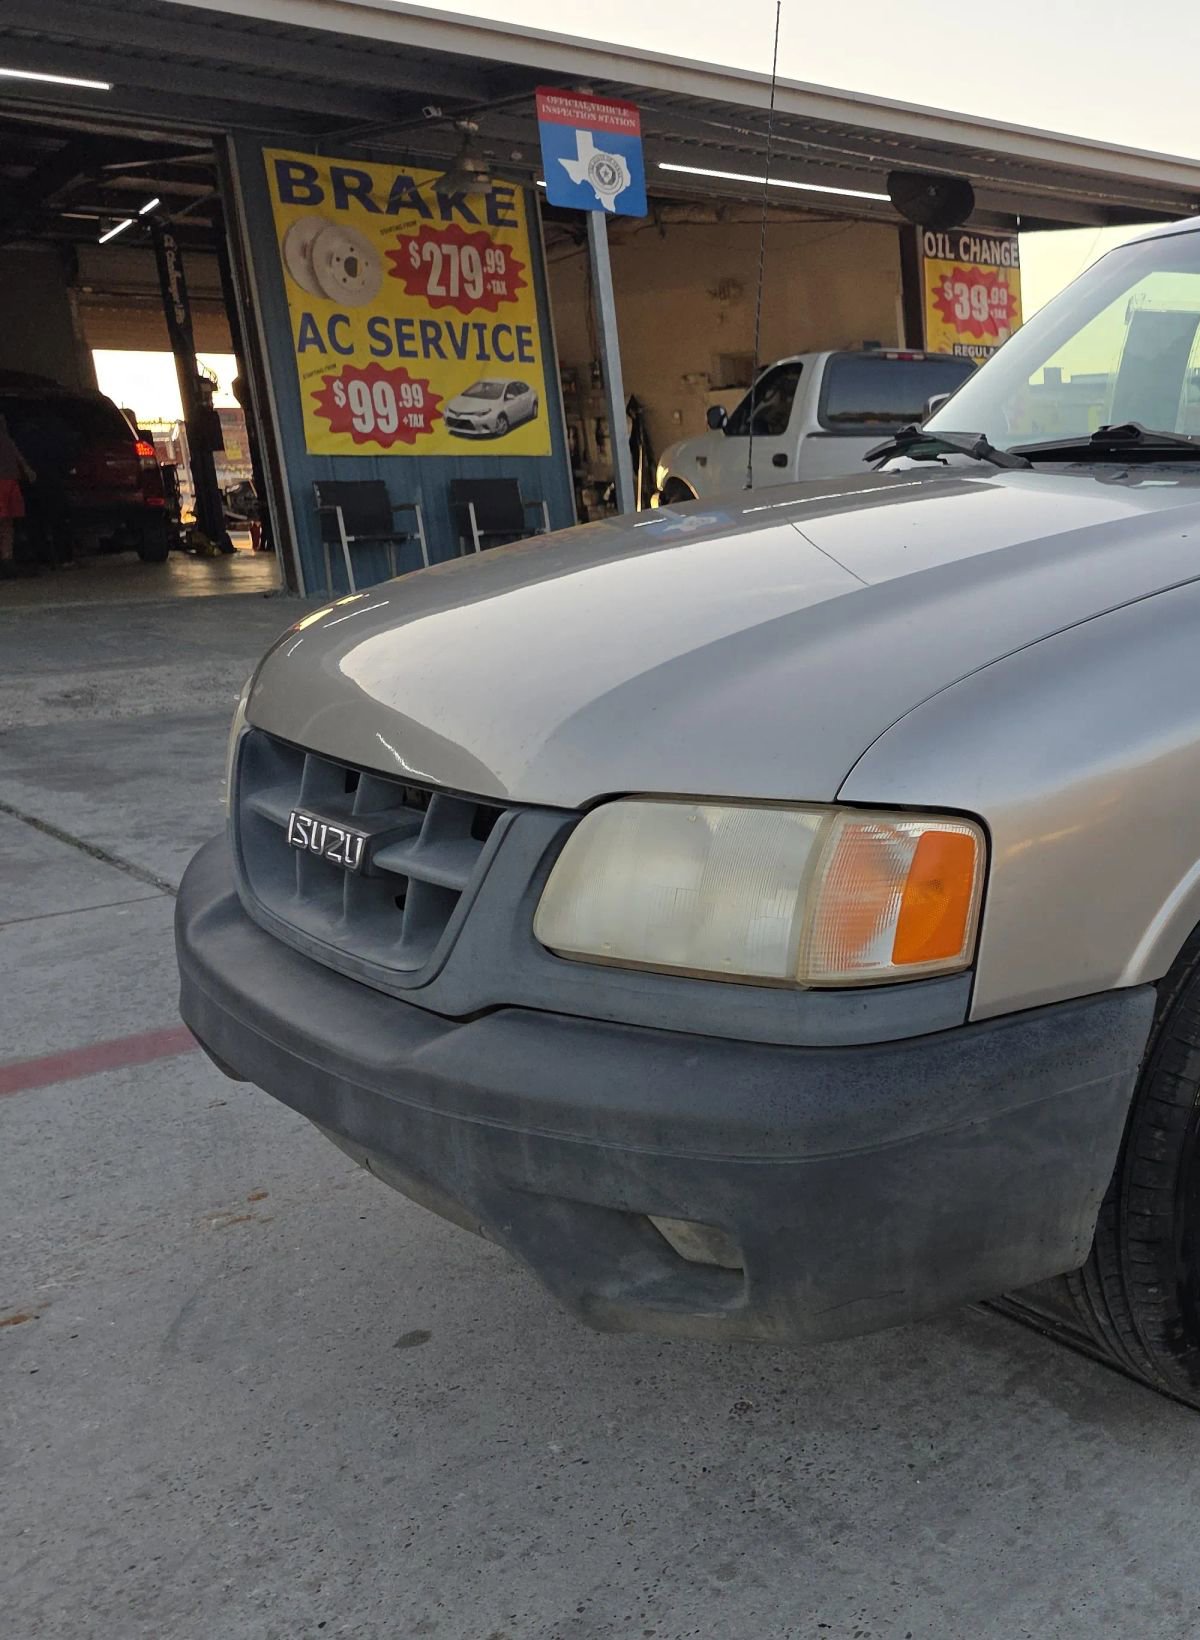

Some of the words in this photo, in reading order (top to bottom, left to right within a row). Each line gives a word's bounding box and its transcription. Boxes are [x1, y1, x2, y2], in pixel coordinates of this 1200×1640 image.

[542, 104, 596, 121] INSPECTION
[598, 114, 636, 127] STATION
[547, 96, 588, 110] OFFICIAL
[590, 102, 629, 117] VEHICLE
[274, 159, 519, 229] BRAKE
[924, 231, 955, 259] OIL
[960, 236, 1019, 267] CHANGE
[298, 312, 354, 355] AC
[367, 316, 536, 364] SERVICE
[288, 812, 364, 869] ISUZU
